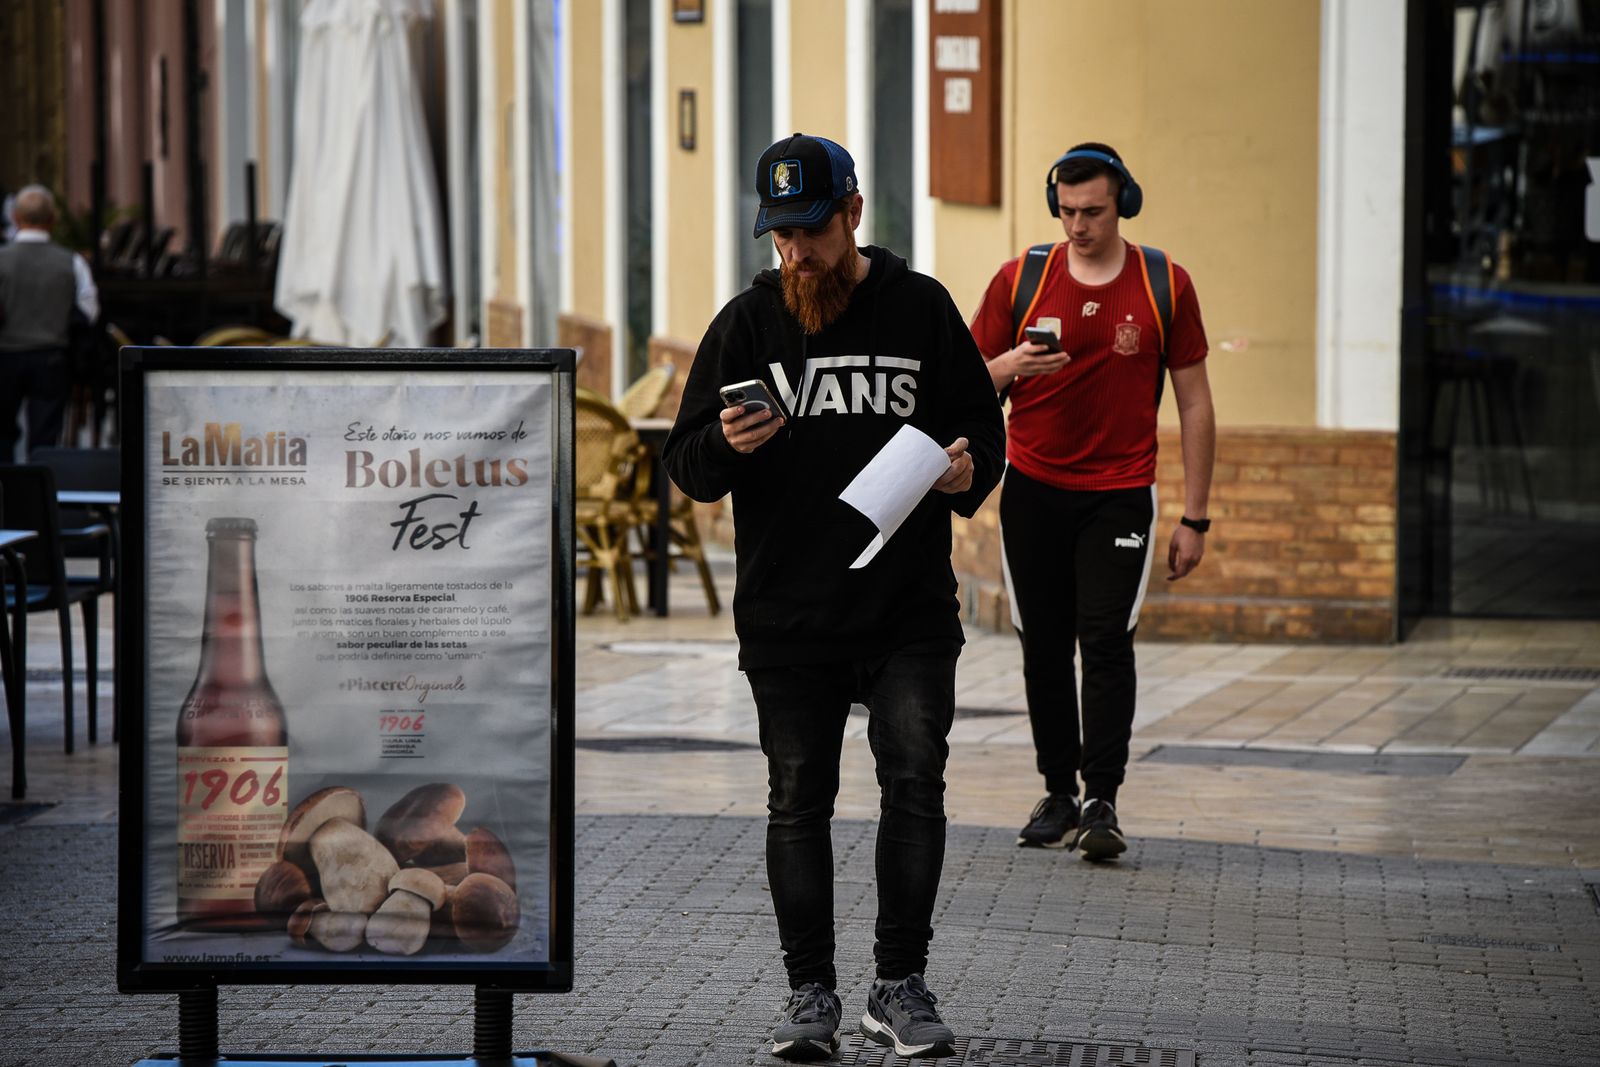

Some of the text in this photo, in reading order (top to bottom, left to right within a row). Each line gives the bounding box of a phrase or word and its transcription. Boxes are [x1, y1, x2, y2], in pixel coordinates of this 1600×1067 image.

[768, 355, 921, 417] VANS
[343, 421, 378, 441] Este
[423, 431, 452, 441] nos
[456, 431, 508, 441] vamos
[511, 419, 528, 444] de
[344, 448, 529, 488] Boletus
[161, 477, 306, 486] SE SIENTA A LA MESA
[390, 493, 482, 551] Fest
[289, 583, 305, 592] Los
[307, 582, 344, 592] sabores
[355, 582, 383, 591] malta
[385, 581, 444, 593] ligeramente
[446, 581, 487, 590] tostados
[489, 580, 502, 590] de
[504, 580, 513, 590] la
[345, 594, 369, 602] 1906
[371, 593, 411, 602] Reserva
[309, 607, 337, 615] como
[339, 606, 353, 615] las
[354, 607, 386, 615] suaves
[388, 606, 415, 615] notas
[417, 605, 430, 614] de
[432, 604, 478, 614] caramelo
[319, 617, 333, 626] los
[335, 617, 373, 627] matices
[375, 616, 410, 626] florales
[419, 617, 460, 626] herbales
[462, 616, 479, 625] del
[480, 614, 512, 627] lúpulo
[382, 629, 408, 638] buen
[409, 629, 480, 639] complemento
[336, 640, 468, 651] sabor peculiar de las setas
[337, 652, 369, 662] podría
[370, 651, 413, 660] definirse
[414, 652, 443, 660] como
[379, 714, 425, 732] 1906
[183, 765, 283, 810] 1906
[183, 843, 236, 869] RESERVA
